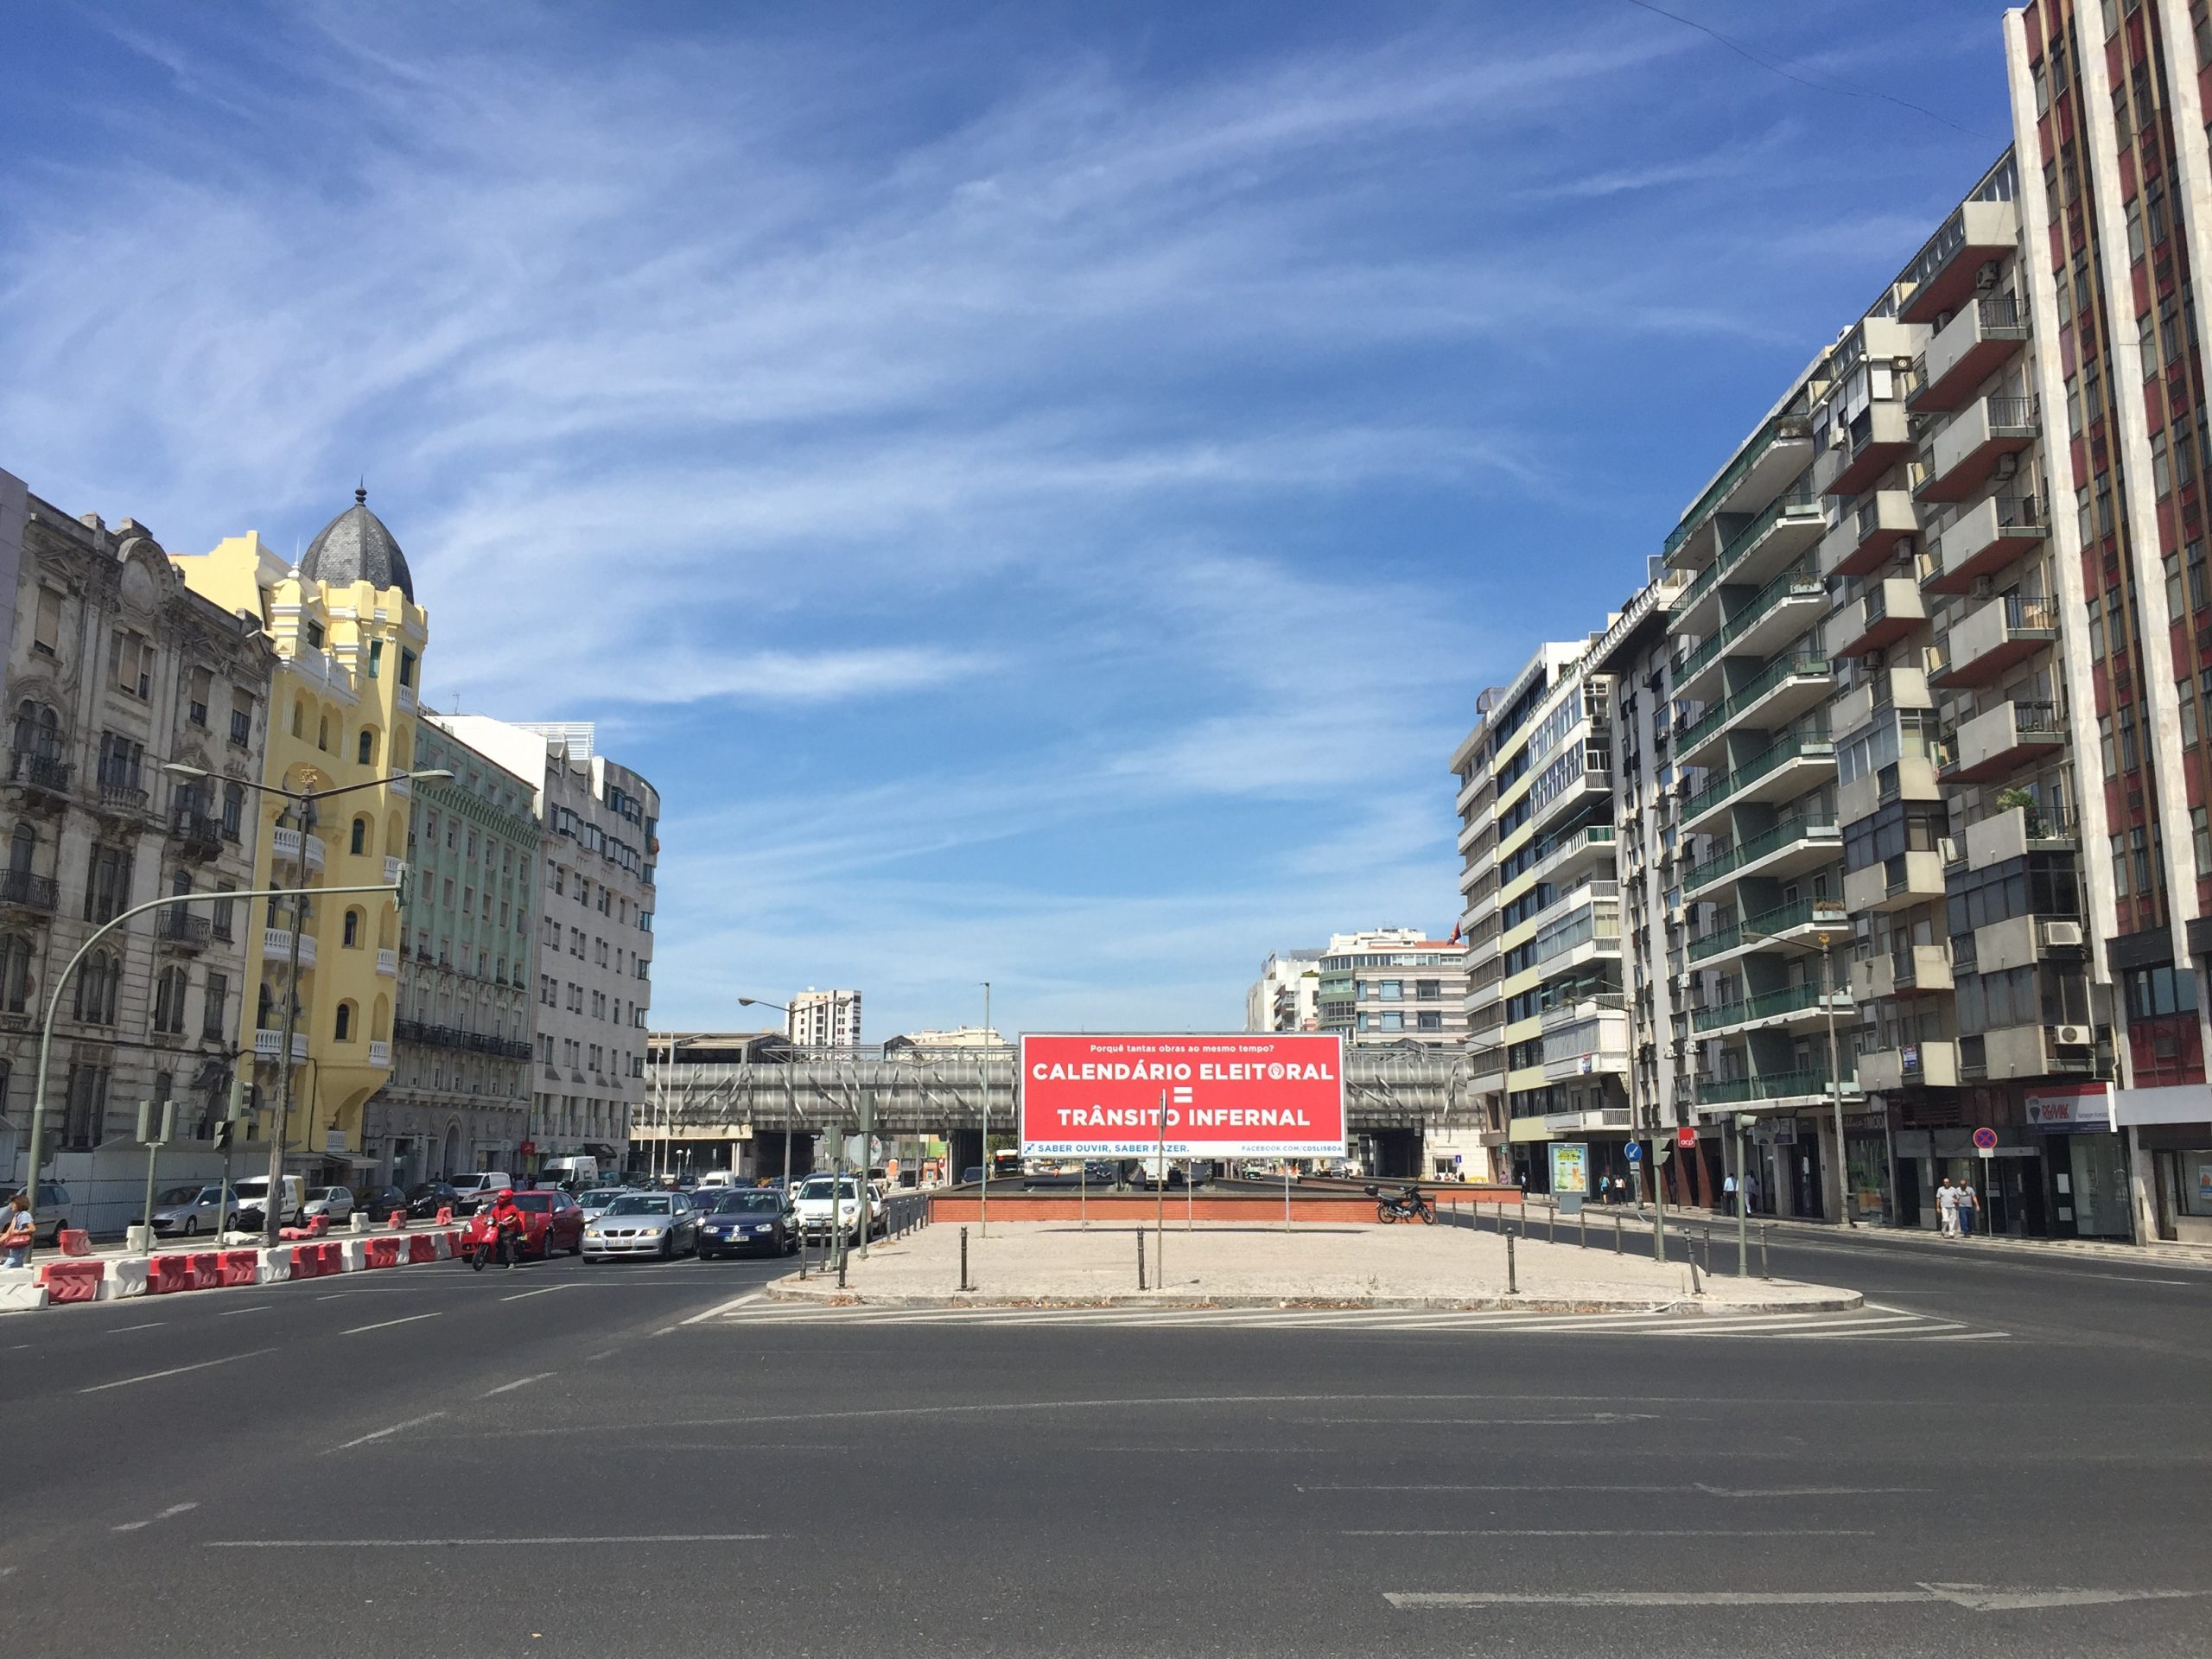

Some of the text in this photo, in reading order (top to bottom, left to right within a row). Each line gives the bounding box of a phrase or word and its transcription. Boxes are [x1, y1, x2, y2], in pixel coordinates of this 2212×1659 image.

[1090, 1044, 1124, 1053] Porquê
[1159, 1044, 1185, 1052] obras
[1239, 1045, 1274, 1054] tempo?
[1032, 1059, 1334, 1081] CALENDÁRIO ELEITORAL
[1057, 1104, 1311, 1127] TRÂNSITO INFERNAL
[1038, 1144, 1072, 1153] SABER
[1077, 1144, 1112, 1154] OUVIR,
[1115, 1144, 1149, 1153] SABER
